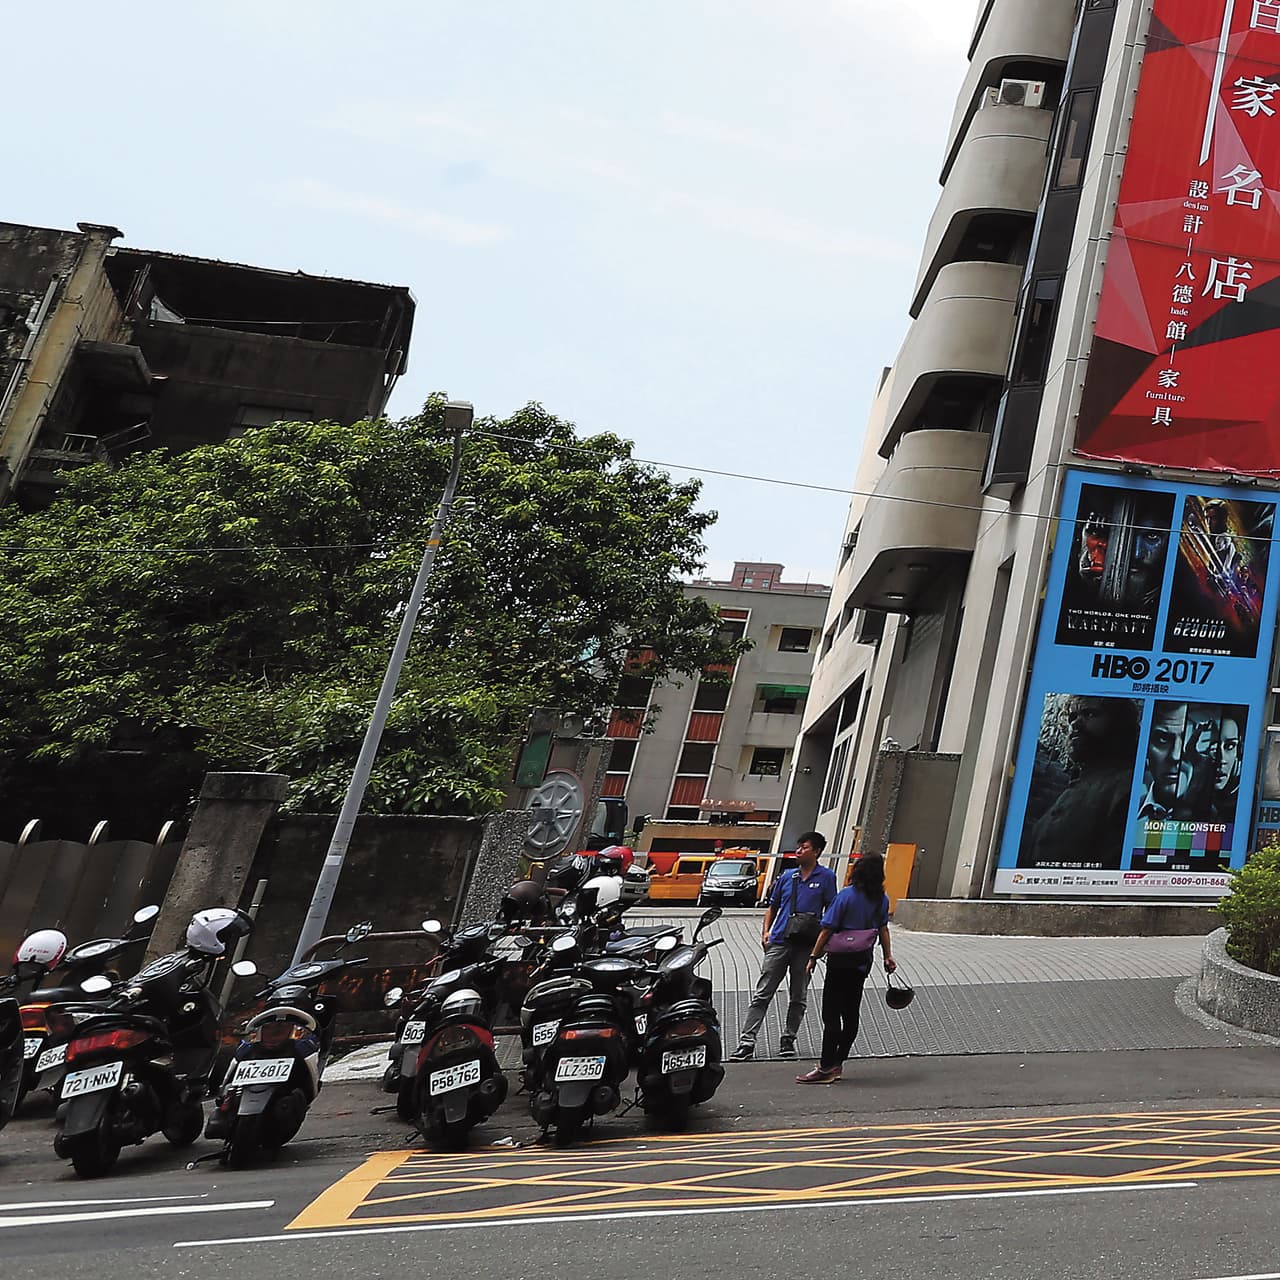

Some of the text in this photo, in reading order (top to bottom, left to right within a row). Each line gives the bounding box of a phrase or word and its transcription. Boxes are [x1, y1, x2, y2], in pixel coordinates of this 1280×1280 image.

[1183, 200, 1209, 212] design
[1145, 390, 1186, 402] furniture
[1173, 622, 1227, 640] BEYOND
[1091, 653, 1215, 685] HBO 2017
[1144, 820, 1227, 834] MONEY MONSTER
[65, 1070, 119, 1094] 721-NNX
[432, 1067, 479, 1093] P58-762
